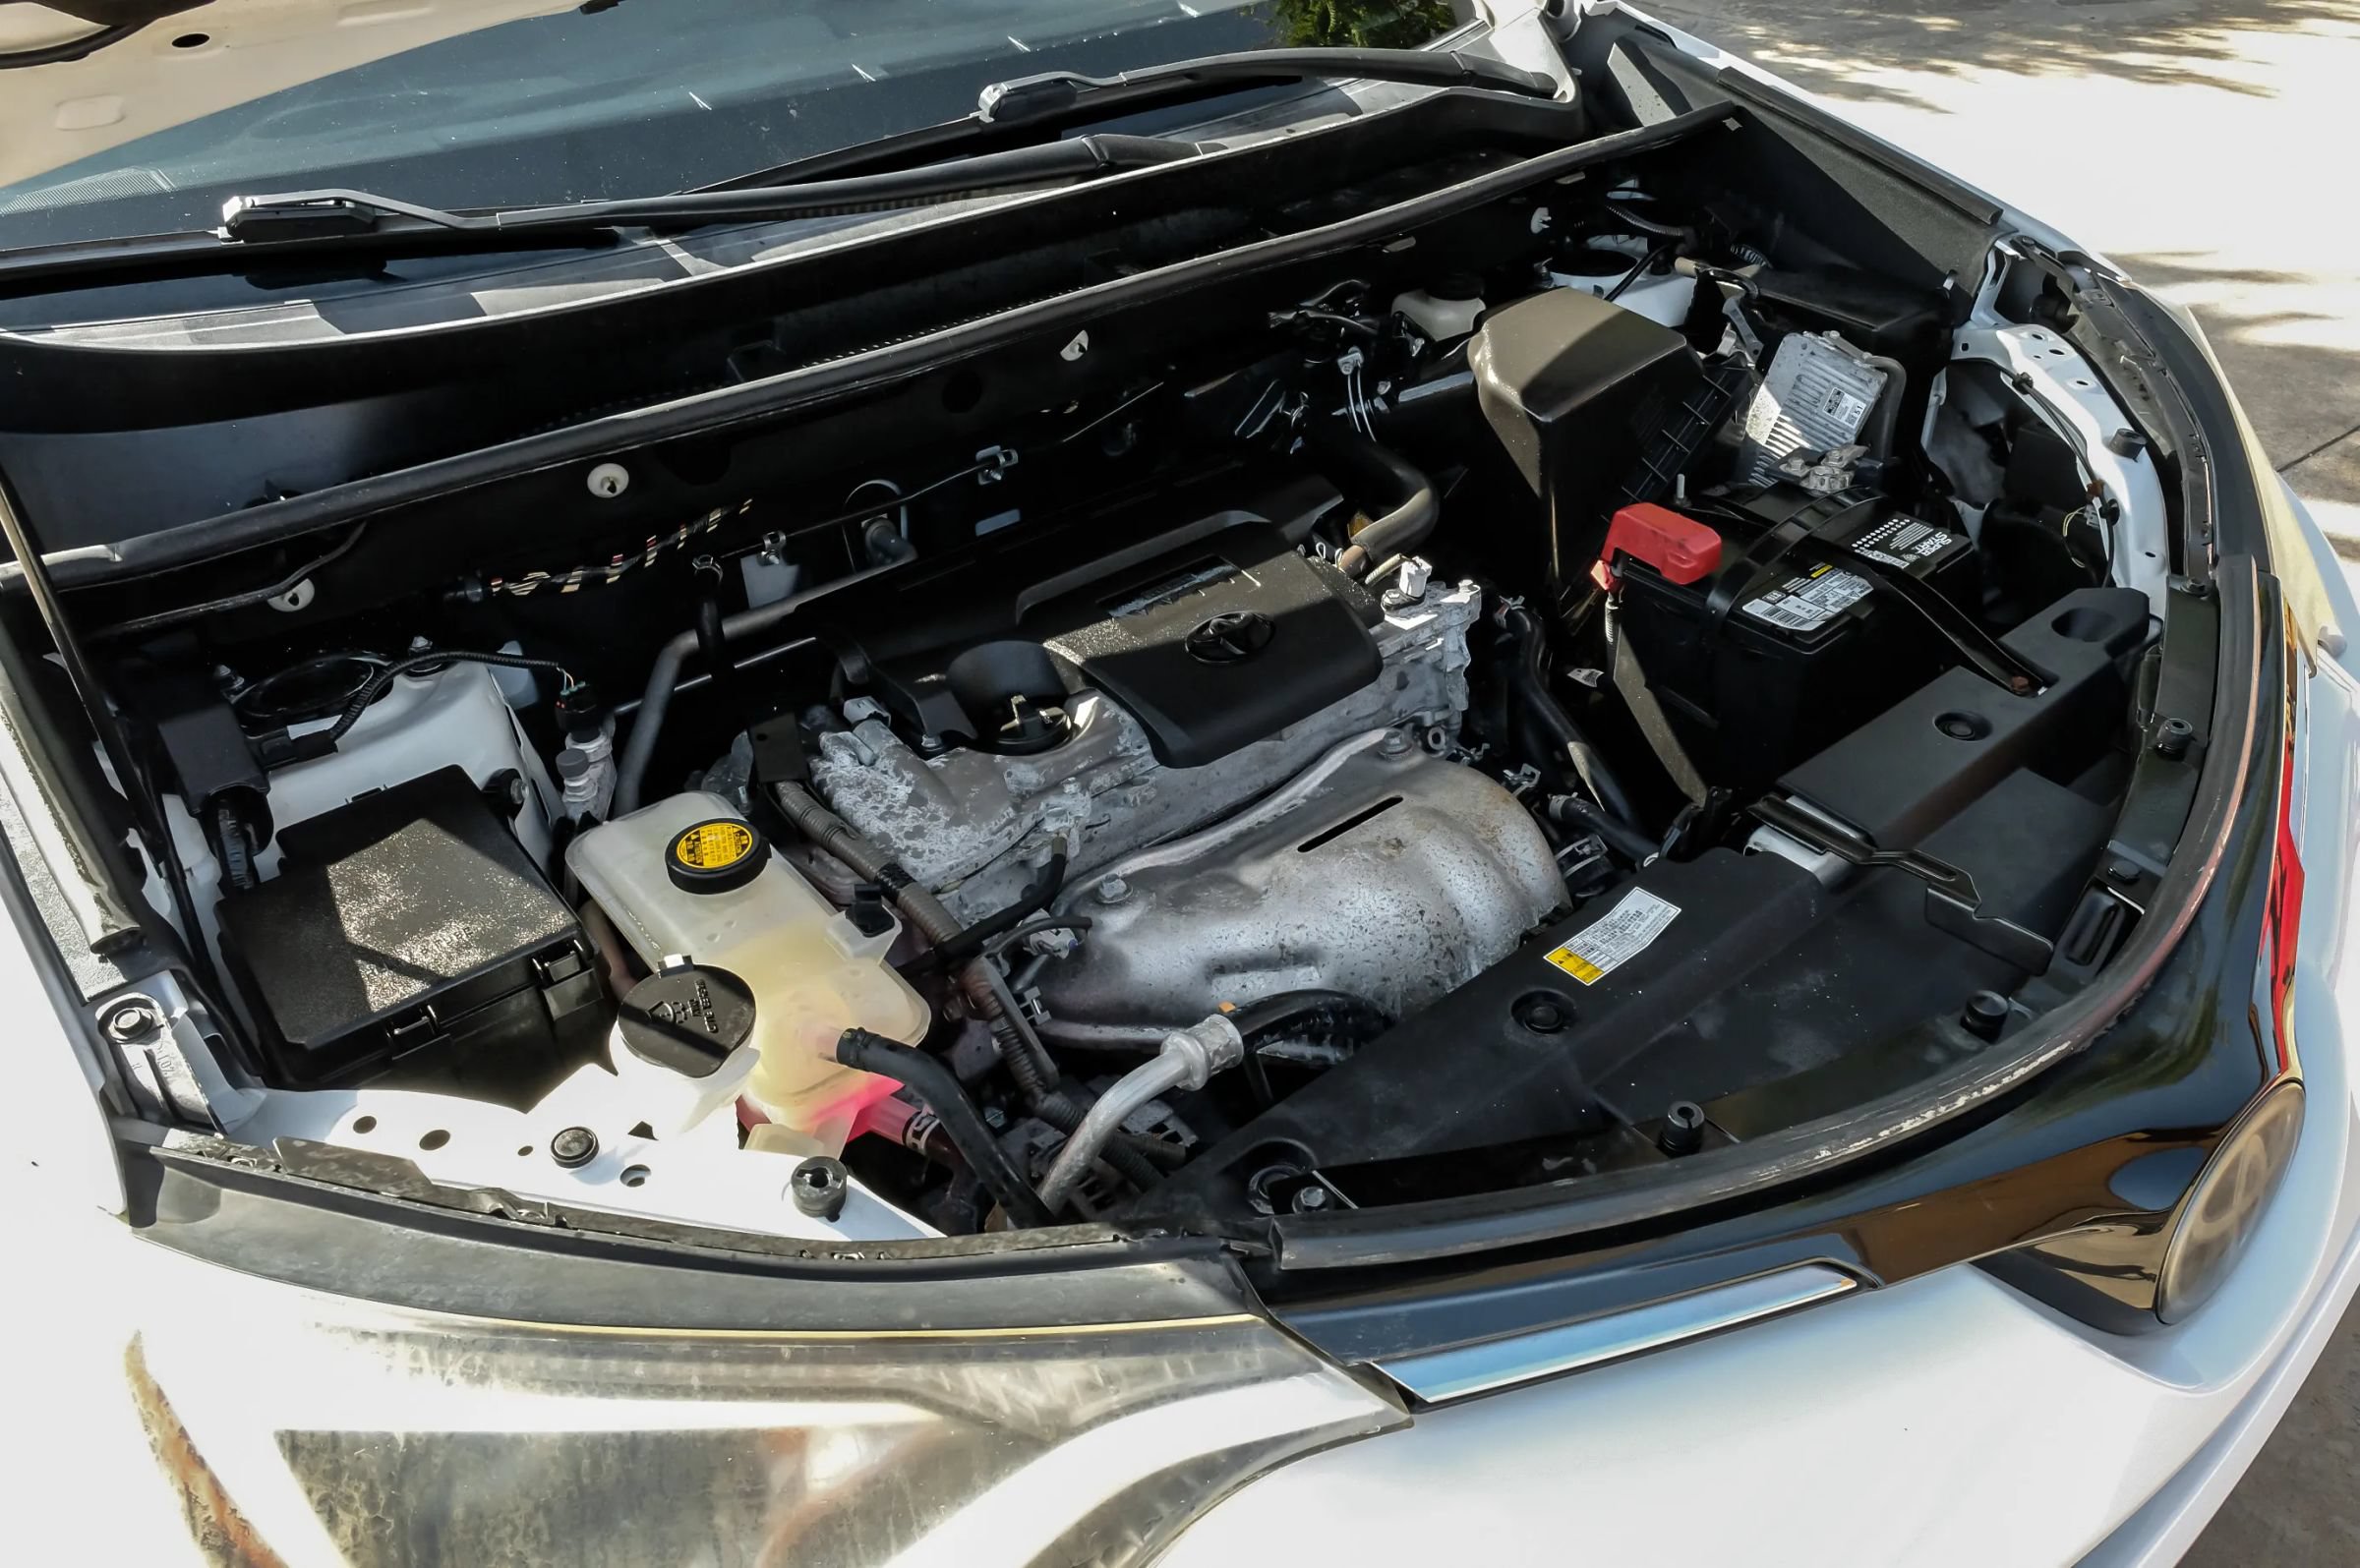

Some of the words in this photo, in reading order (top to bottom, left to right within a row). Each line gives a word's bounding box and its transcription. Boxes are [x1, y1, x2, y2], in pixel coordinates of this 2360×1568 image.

[1915, 531, 1948, 554] START
[1919, 538, 1953, 556] SUPER
[734, 832, 742, 855] CAUTION
[687, 998, 702, 1017] ONLY
